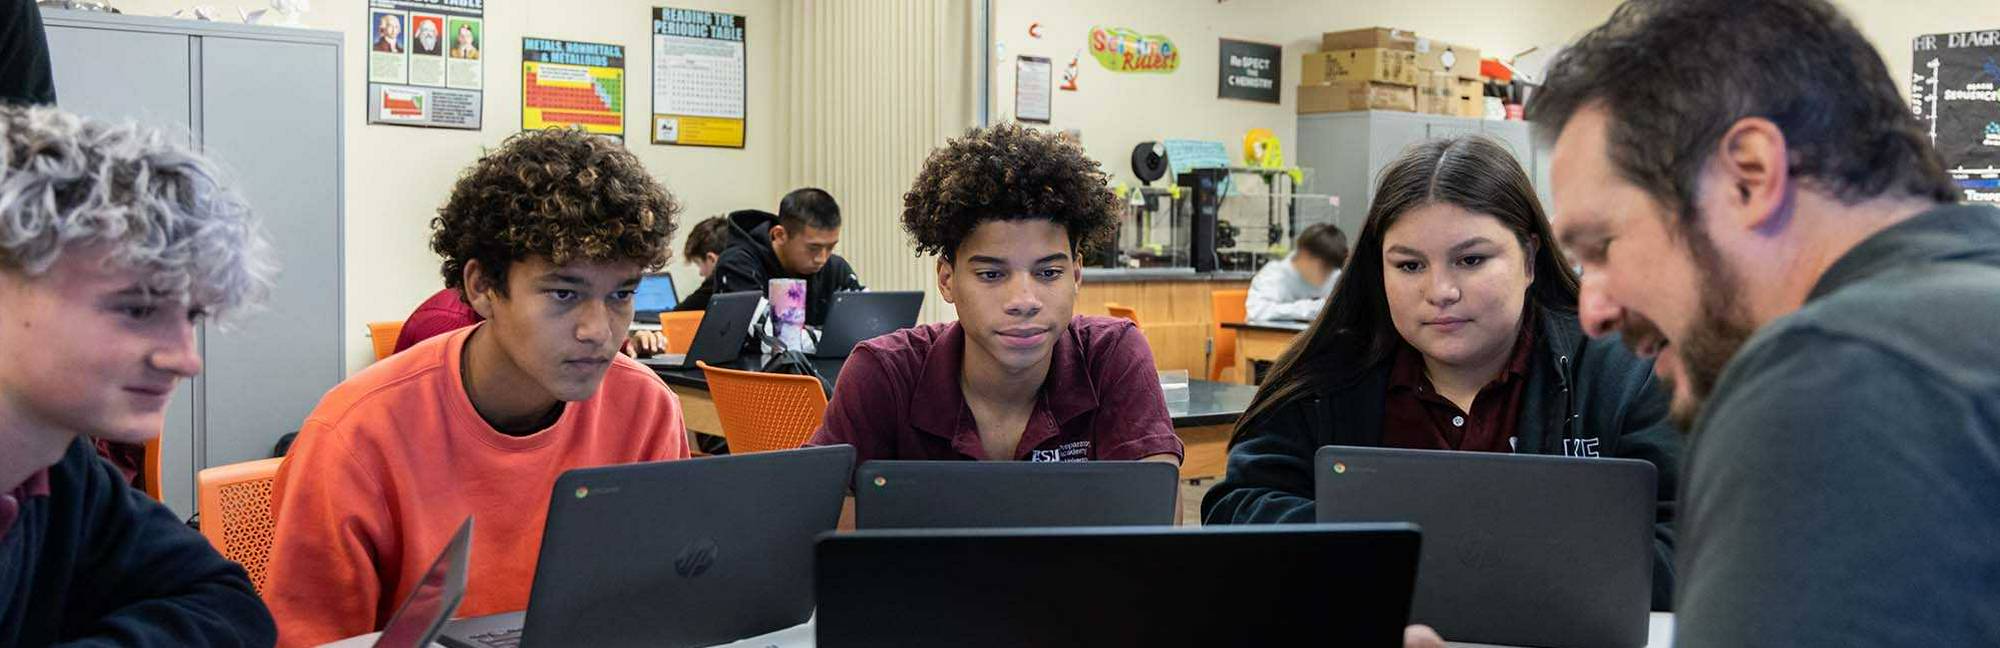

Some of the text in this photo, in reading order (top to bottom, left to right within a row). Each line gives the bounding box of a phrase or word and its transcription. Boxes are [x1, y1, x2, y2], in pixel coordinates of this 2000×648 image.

[662, 8, 735, 27] READING THE
[655, 21, 744, 40] PERIODIC TABLE
[525, 38, 565, 53] METALS,
[1914, 35, 1937, 51] HR
[541, 52, 608, 67] & METALLOIDS
[1912, 73, 1924, 119] OSITY
